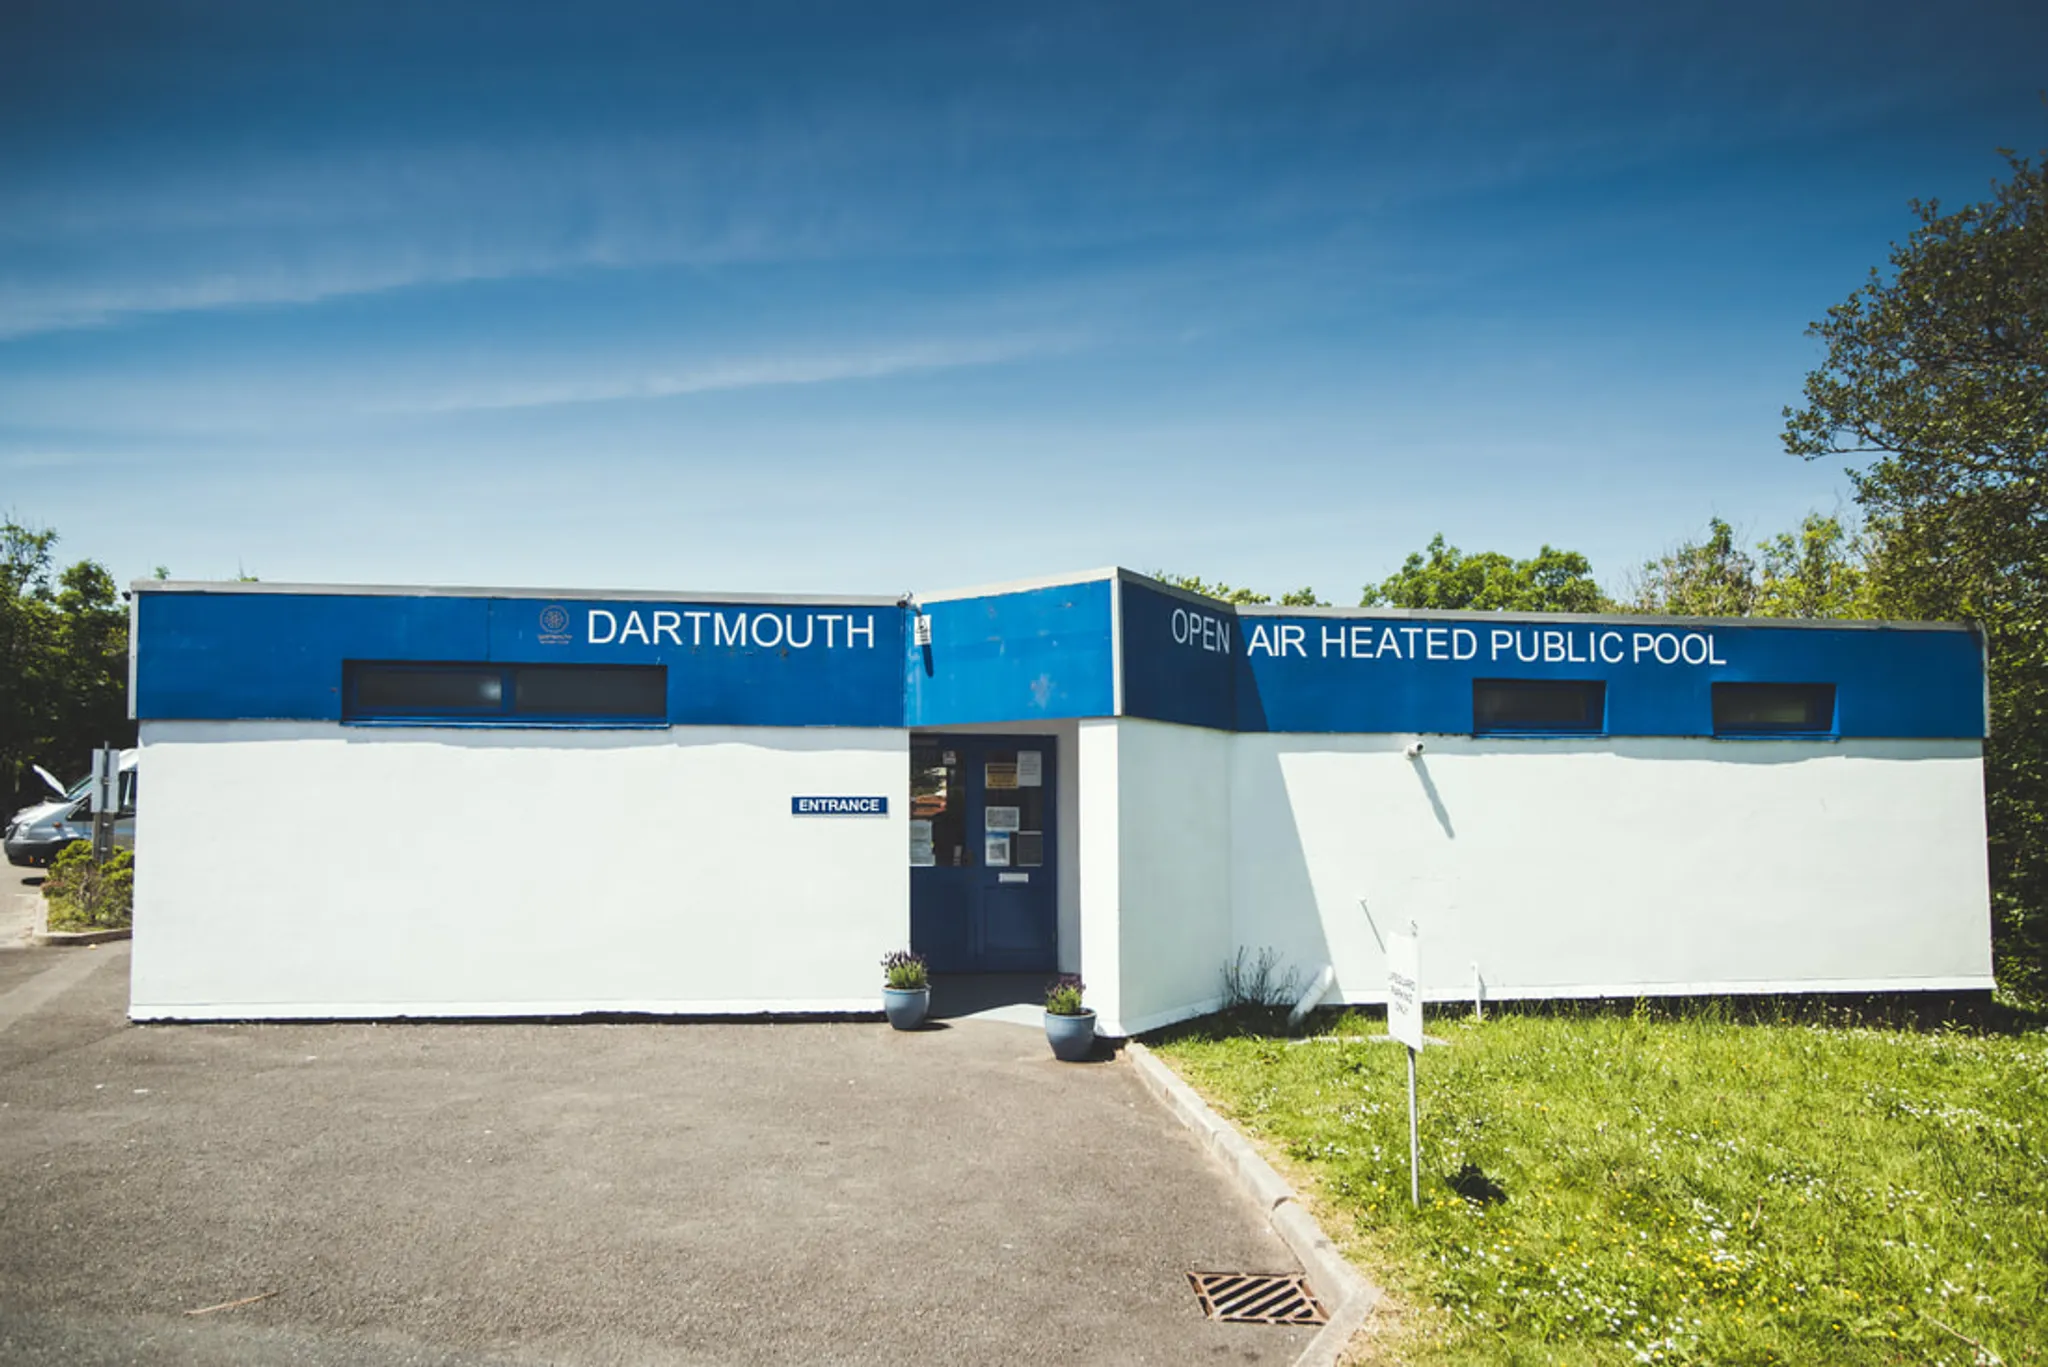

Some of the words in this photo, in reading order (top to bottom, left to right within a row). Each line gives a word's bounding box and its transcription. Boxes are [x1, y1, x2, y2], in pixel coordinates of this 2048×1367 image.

[588, 609, 874, 649] DARTMOUTH
[1171, 608, 1231, 654] OPEN
[1247, 624, 1307, 657] AIR
[1321, 625, 1478, 660] HEATED
[1491, 629, 1625, 663] PUBLIC
[1633, 632, 1727, 665] POOL
[798, 798, 880, 812] ENTRANCE
